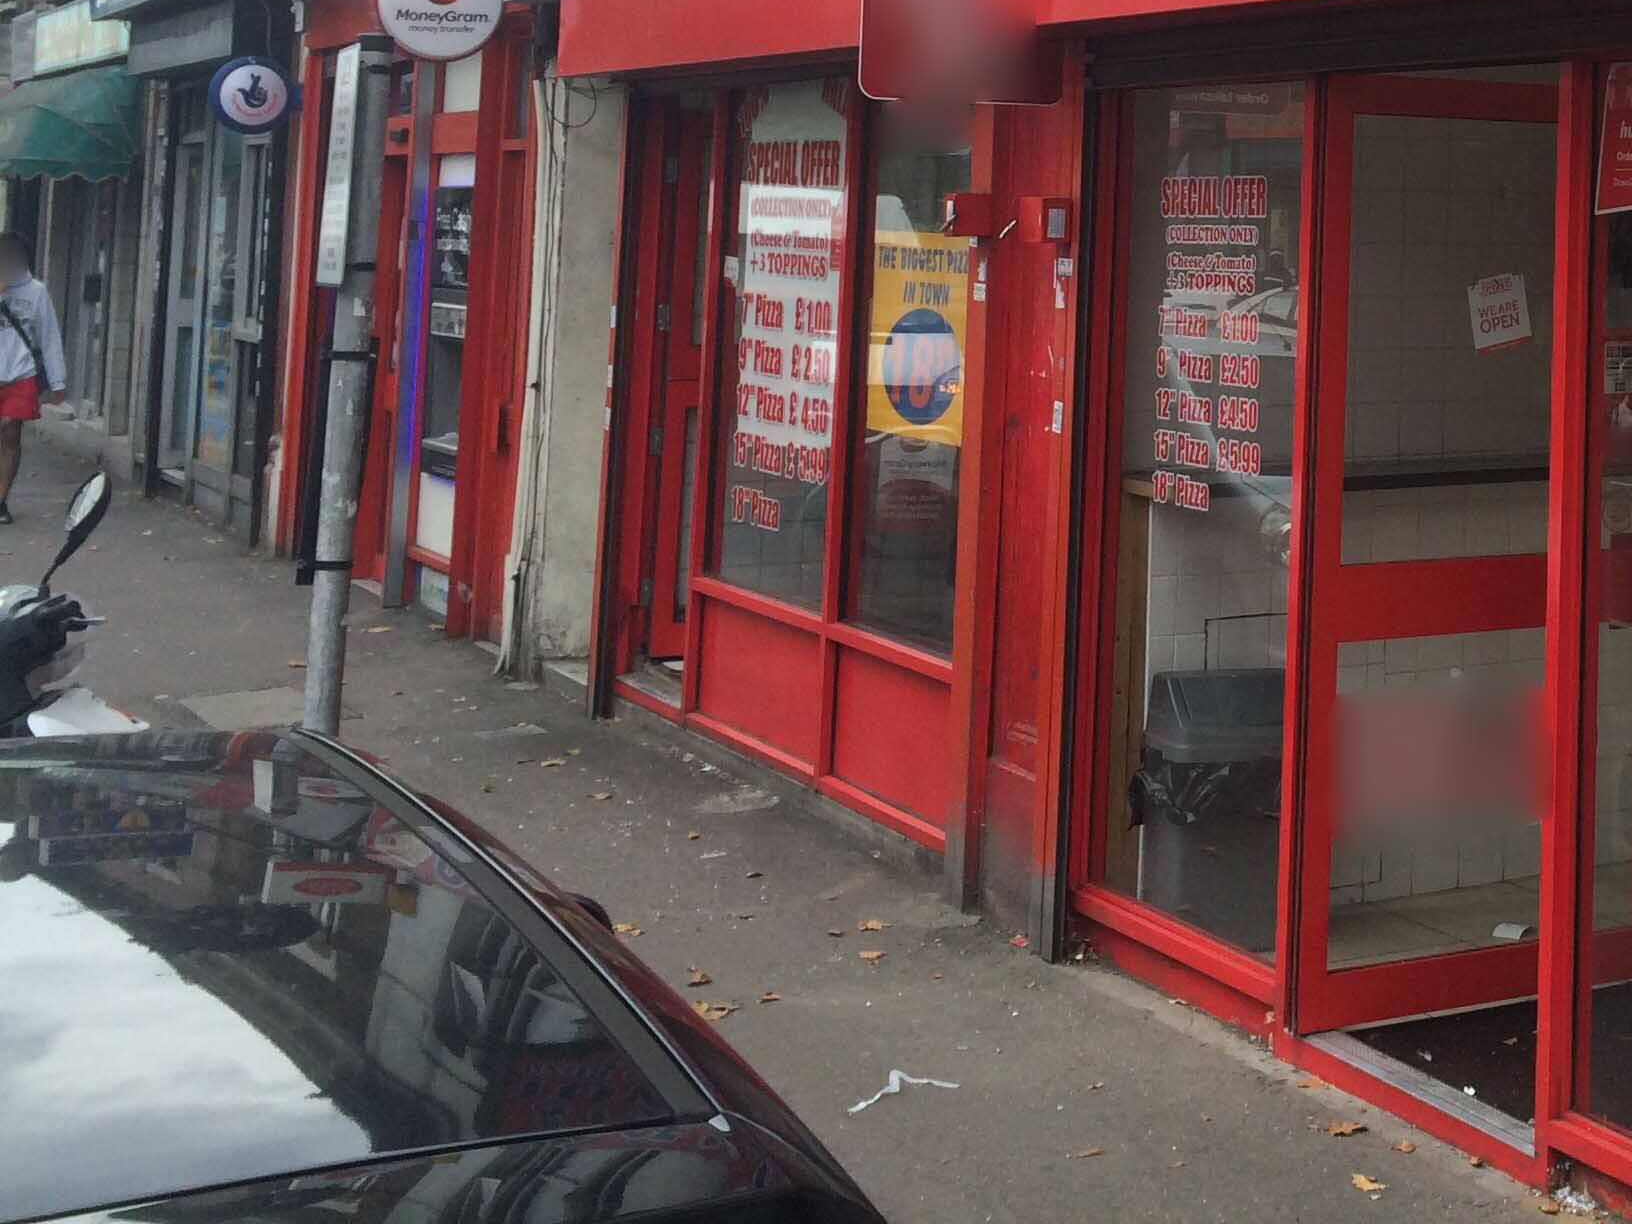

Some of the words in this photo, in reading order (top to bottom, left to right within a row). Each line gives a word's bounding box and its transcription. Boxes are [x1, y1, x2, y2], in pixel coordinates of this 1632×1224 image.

[395, 9, 489, 24] MoneyGram
[749, 139, 798, 186] SPECIAL
[801, 140, 840, 186] OFFER
[1161, 176, 1219, 218] SPECIAL
[1221, 176, 1267, 218] OFFER
[767, 252, 826, 278] TOPPINGS
[879, 247, 896, 270] THE
[901, 247, 945, 273] BIGGEST
[1167, 252, 1203, 270] (Cheese
[1214, 253, 1256, 272] Tomato)
[904, 281, 915, 303] IN
[919, 282, 949, 306] TOWN
[1187, 271, 1256, 295] TOPPINGS
[755, 294, 783, 329] Pizza
[1174, 307, 1207, 338] Pizza
[1479, 304, 1497, 318] WE
[1499, 300, 1520, 314] ARE
[1480, 312, 1520, 334] OPEN
[754, 339, 783, 376] Pizza
[1177, 349, 1213, 383] Pizza
[756, 387, 784, 424] Pizza
[1177, 391, 1212, 425] Pizza
[1218, 395, 1258, 432] £4.50
[752, 435, 782, 476] Pizza
[1176, 432, 1210, 468] Pizza
[750, 489, 780, 531] Pizza
[1175, 474, 1209, 512] Pizza
